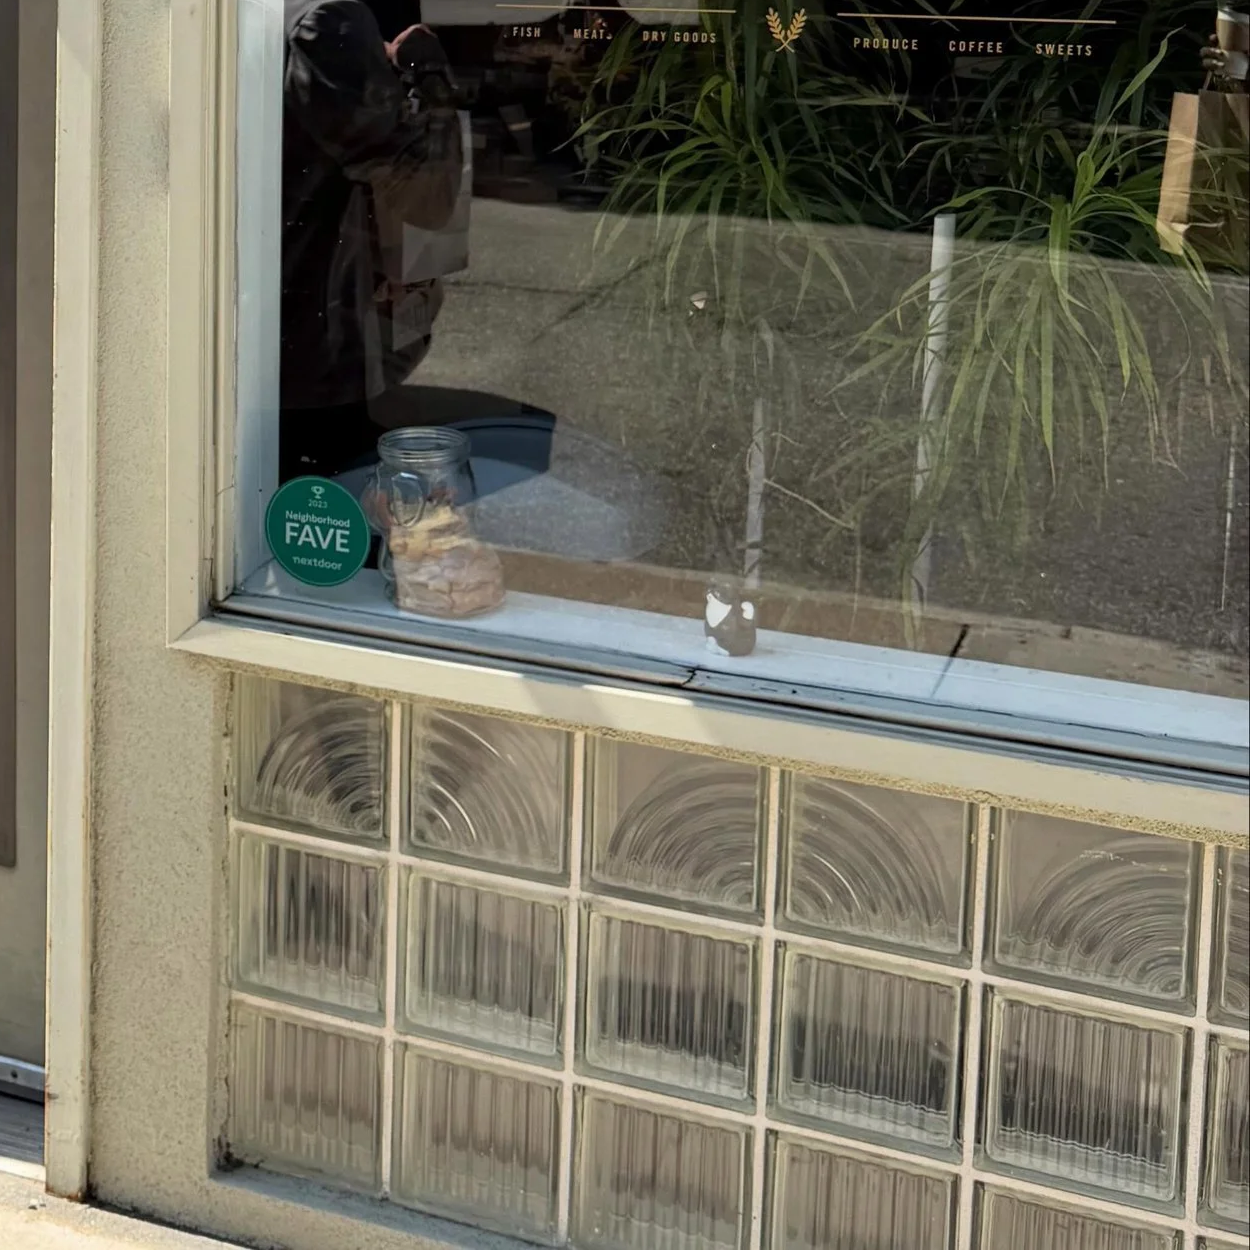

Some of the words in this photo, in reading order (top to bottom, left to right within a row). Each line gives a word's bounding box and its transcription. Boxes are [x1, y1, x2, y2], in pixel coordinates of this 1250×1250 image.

[512, 26, 541, 38] FISH
[642, 30, 666, 43] DRY
[674, 31, 717, 44] GOODS
[853, 37, 918, 50] PRODUCE
[949, 40, 1003, 54] COFFEE
[1035, 43, 1093, 57] SWEETS
[307, 498, 328, 509] 2023
[285, 510, 351, 528] Neighborhood
[284, 522, 350, 553] FAVE
[292, 556, 342, 570] nextdoor
